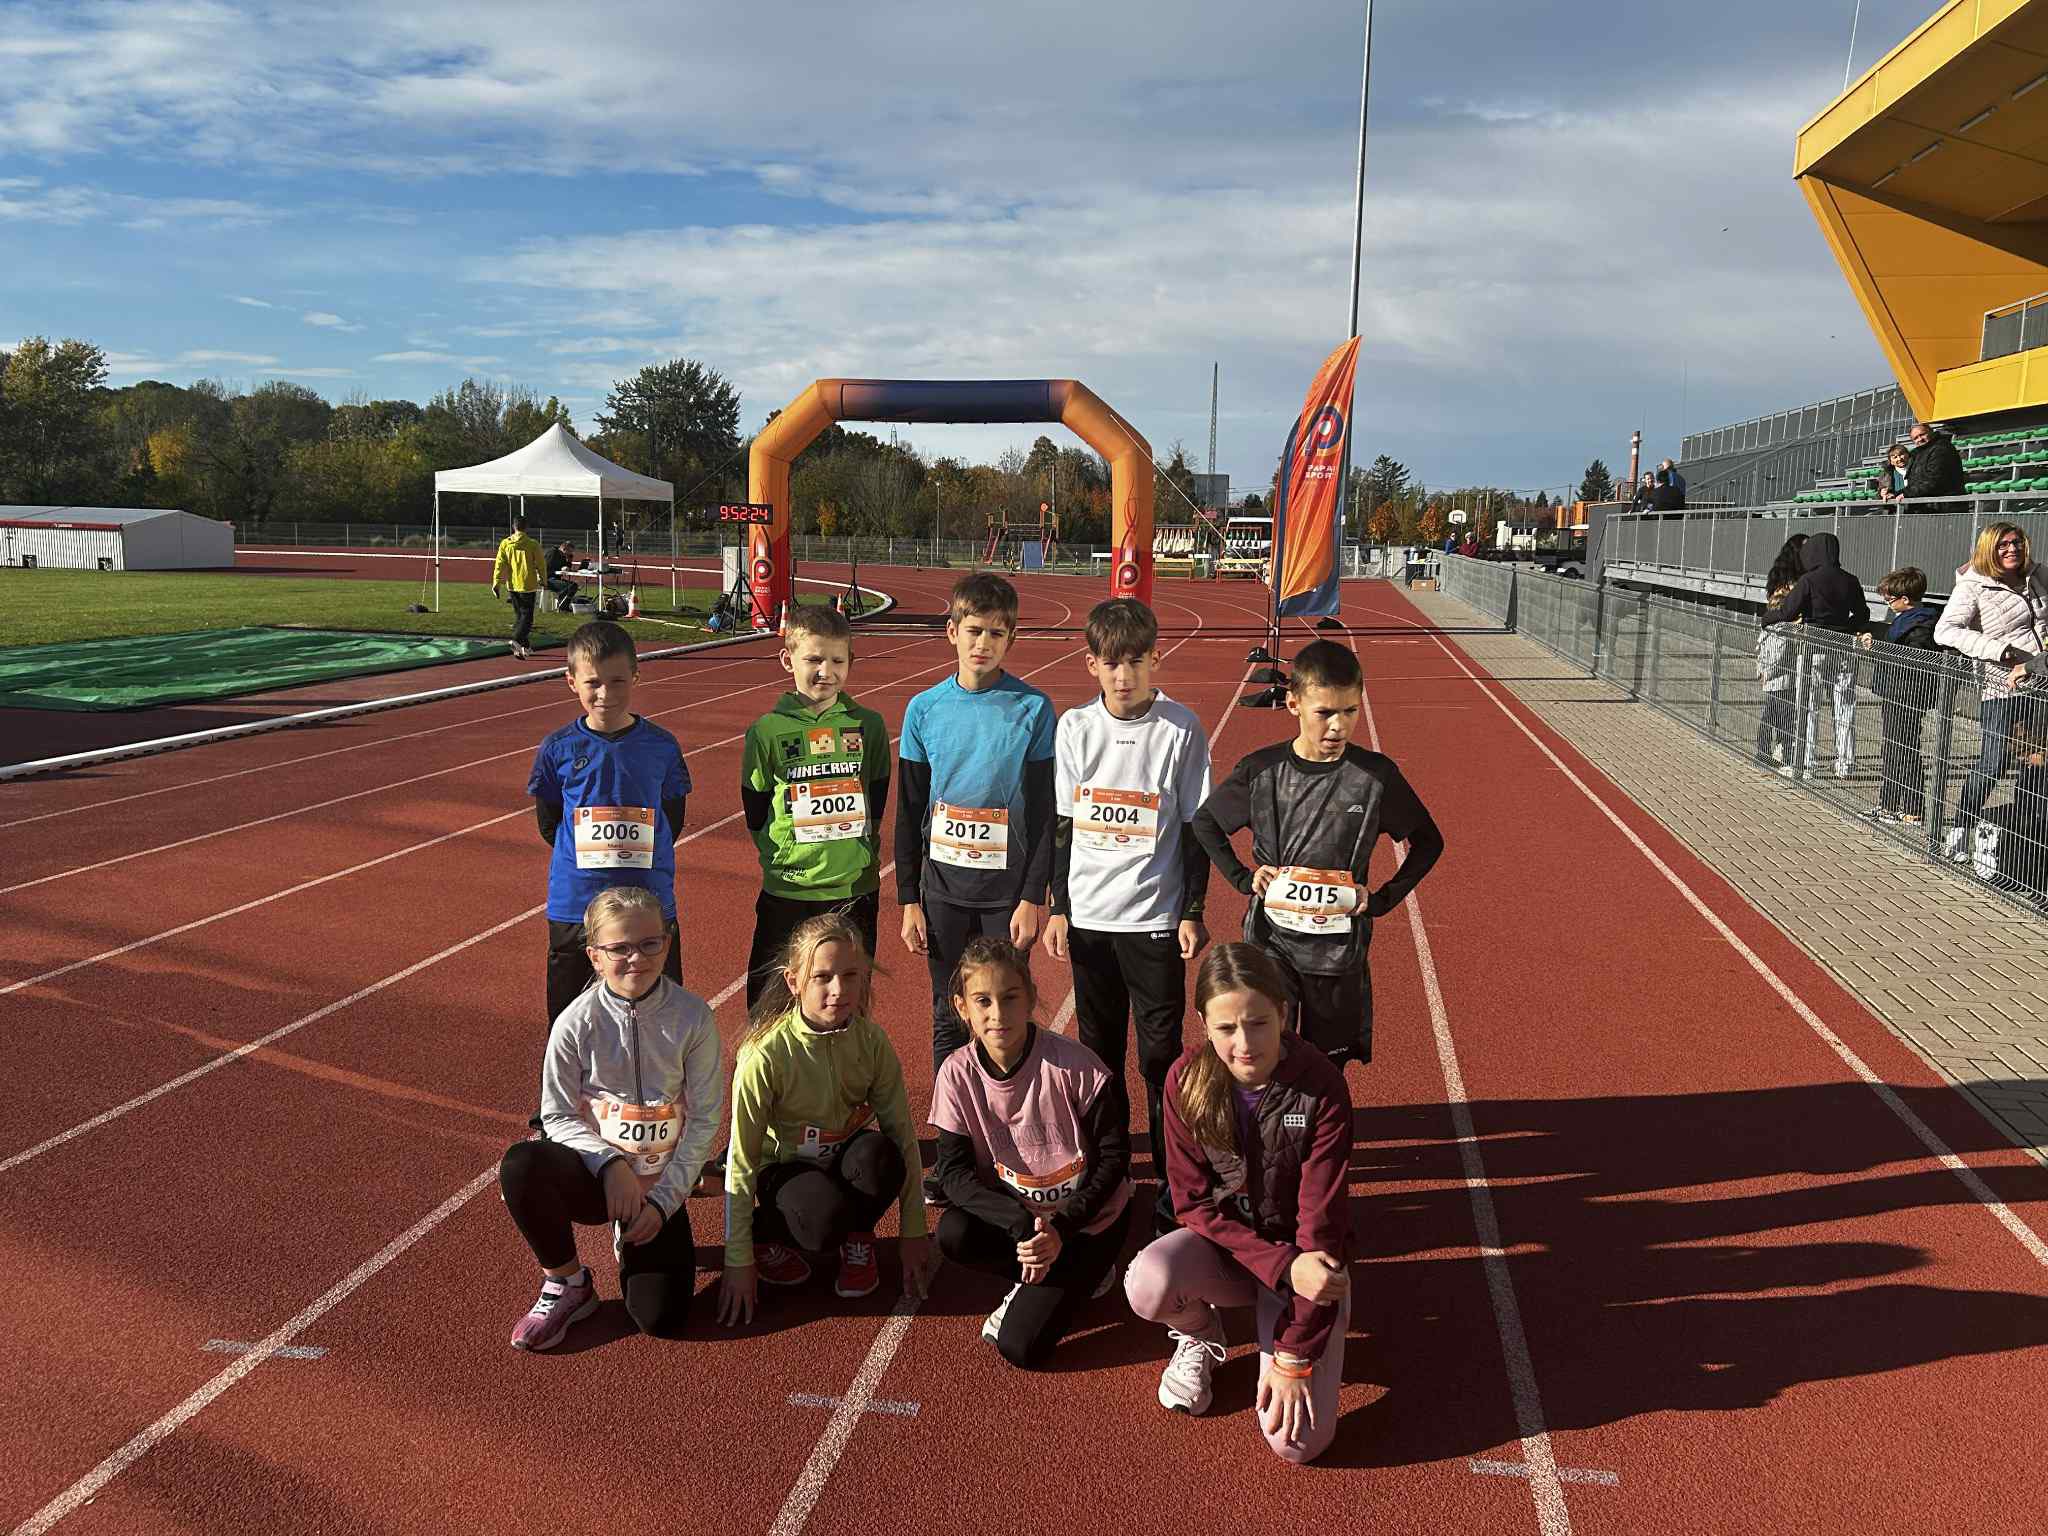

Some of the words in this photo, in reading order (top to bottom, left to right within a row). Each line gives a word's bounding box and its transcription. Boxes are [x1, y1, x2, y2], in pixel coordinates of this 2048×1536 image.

[786, 762, 862, 779] MINECRAFT
[810, 796, 856, 815] 2002
[1090, 805, 1140, 825] 2004
[591, 823, 640, 840] 2006
[945, 820, 991, 840] 2012
[1285, 883, 1338, 904] 2015
[618, 1121, 668, 1142] 2016
[1017, 1180, 1073, 1203] 2005
